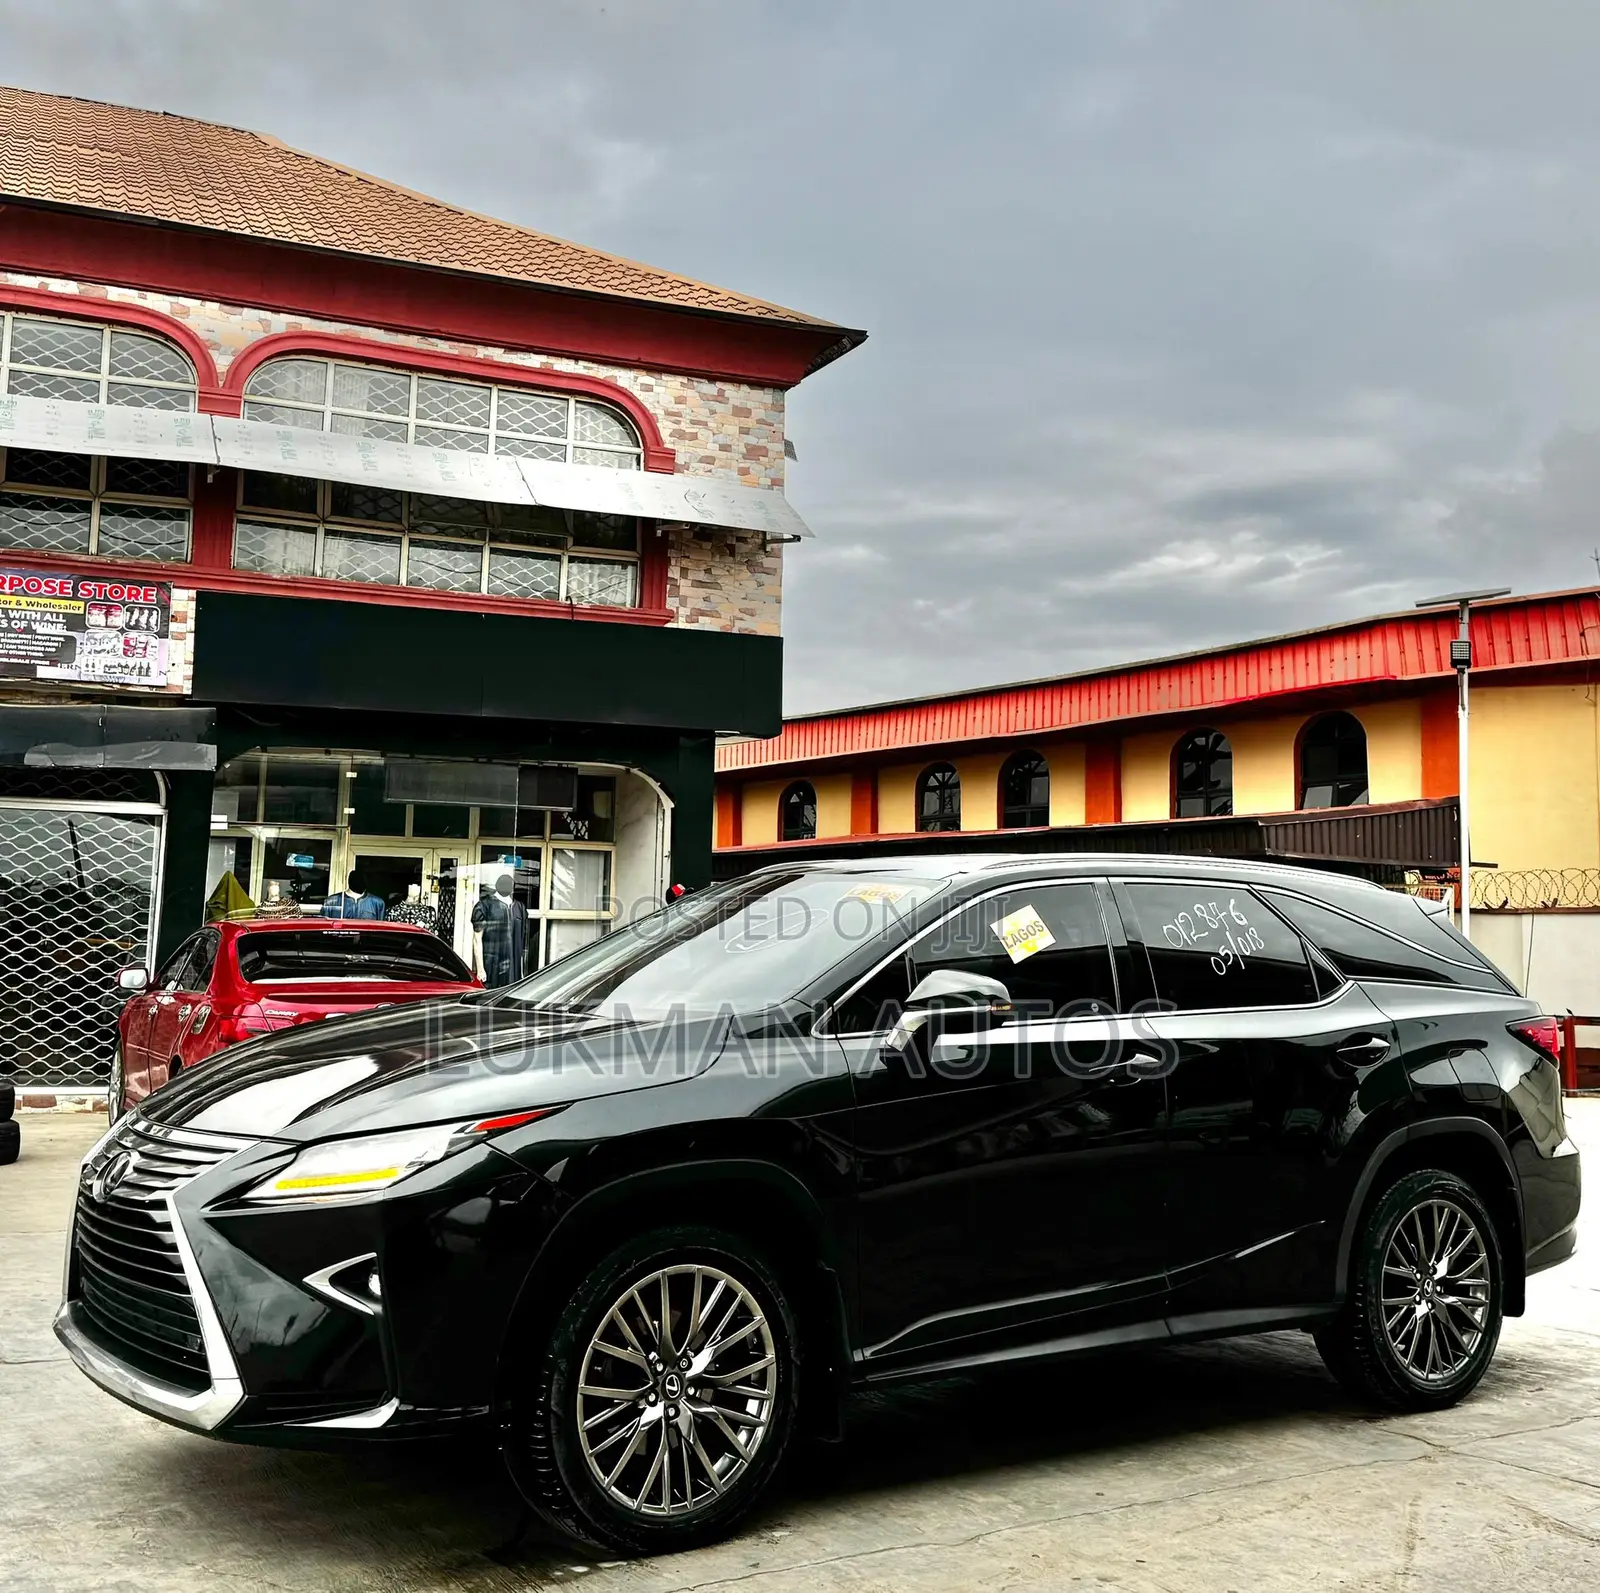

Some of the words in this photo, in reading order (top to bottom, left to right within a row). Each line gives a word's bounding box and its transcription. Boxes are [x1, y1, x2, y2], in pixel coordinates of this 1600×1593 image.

[78, 581, 157, 604] STORE
[25, 600, 82, 612] Wholesaler
[8, 609, 41, 620] WITH
[43, 612, 66, 622] ALL
[10, 619, 28, 629] OF
[1002, 920, 1045, 949] LAGOS
[1210, 926, 1265, 976] 05/018
